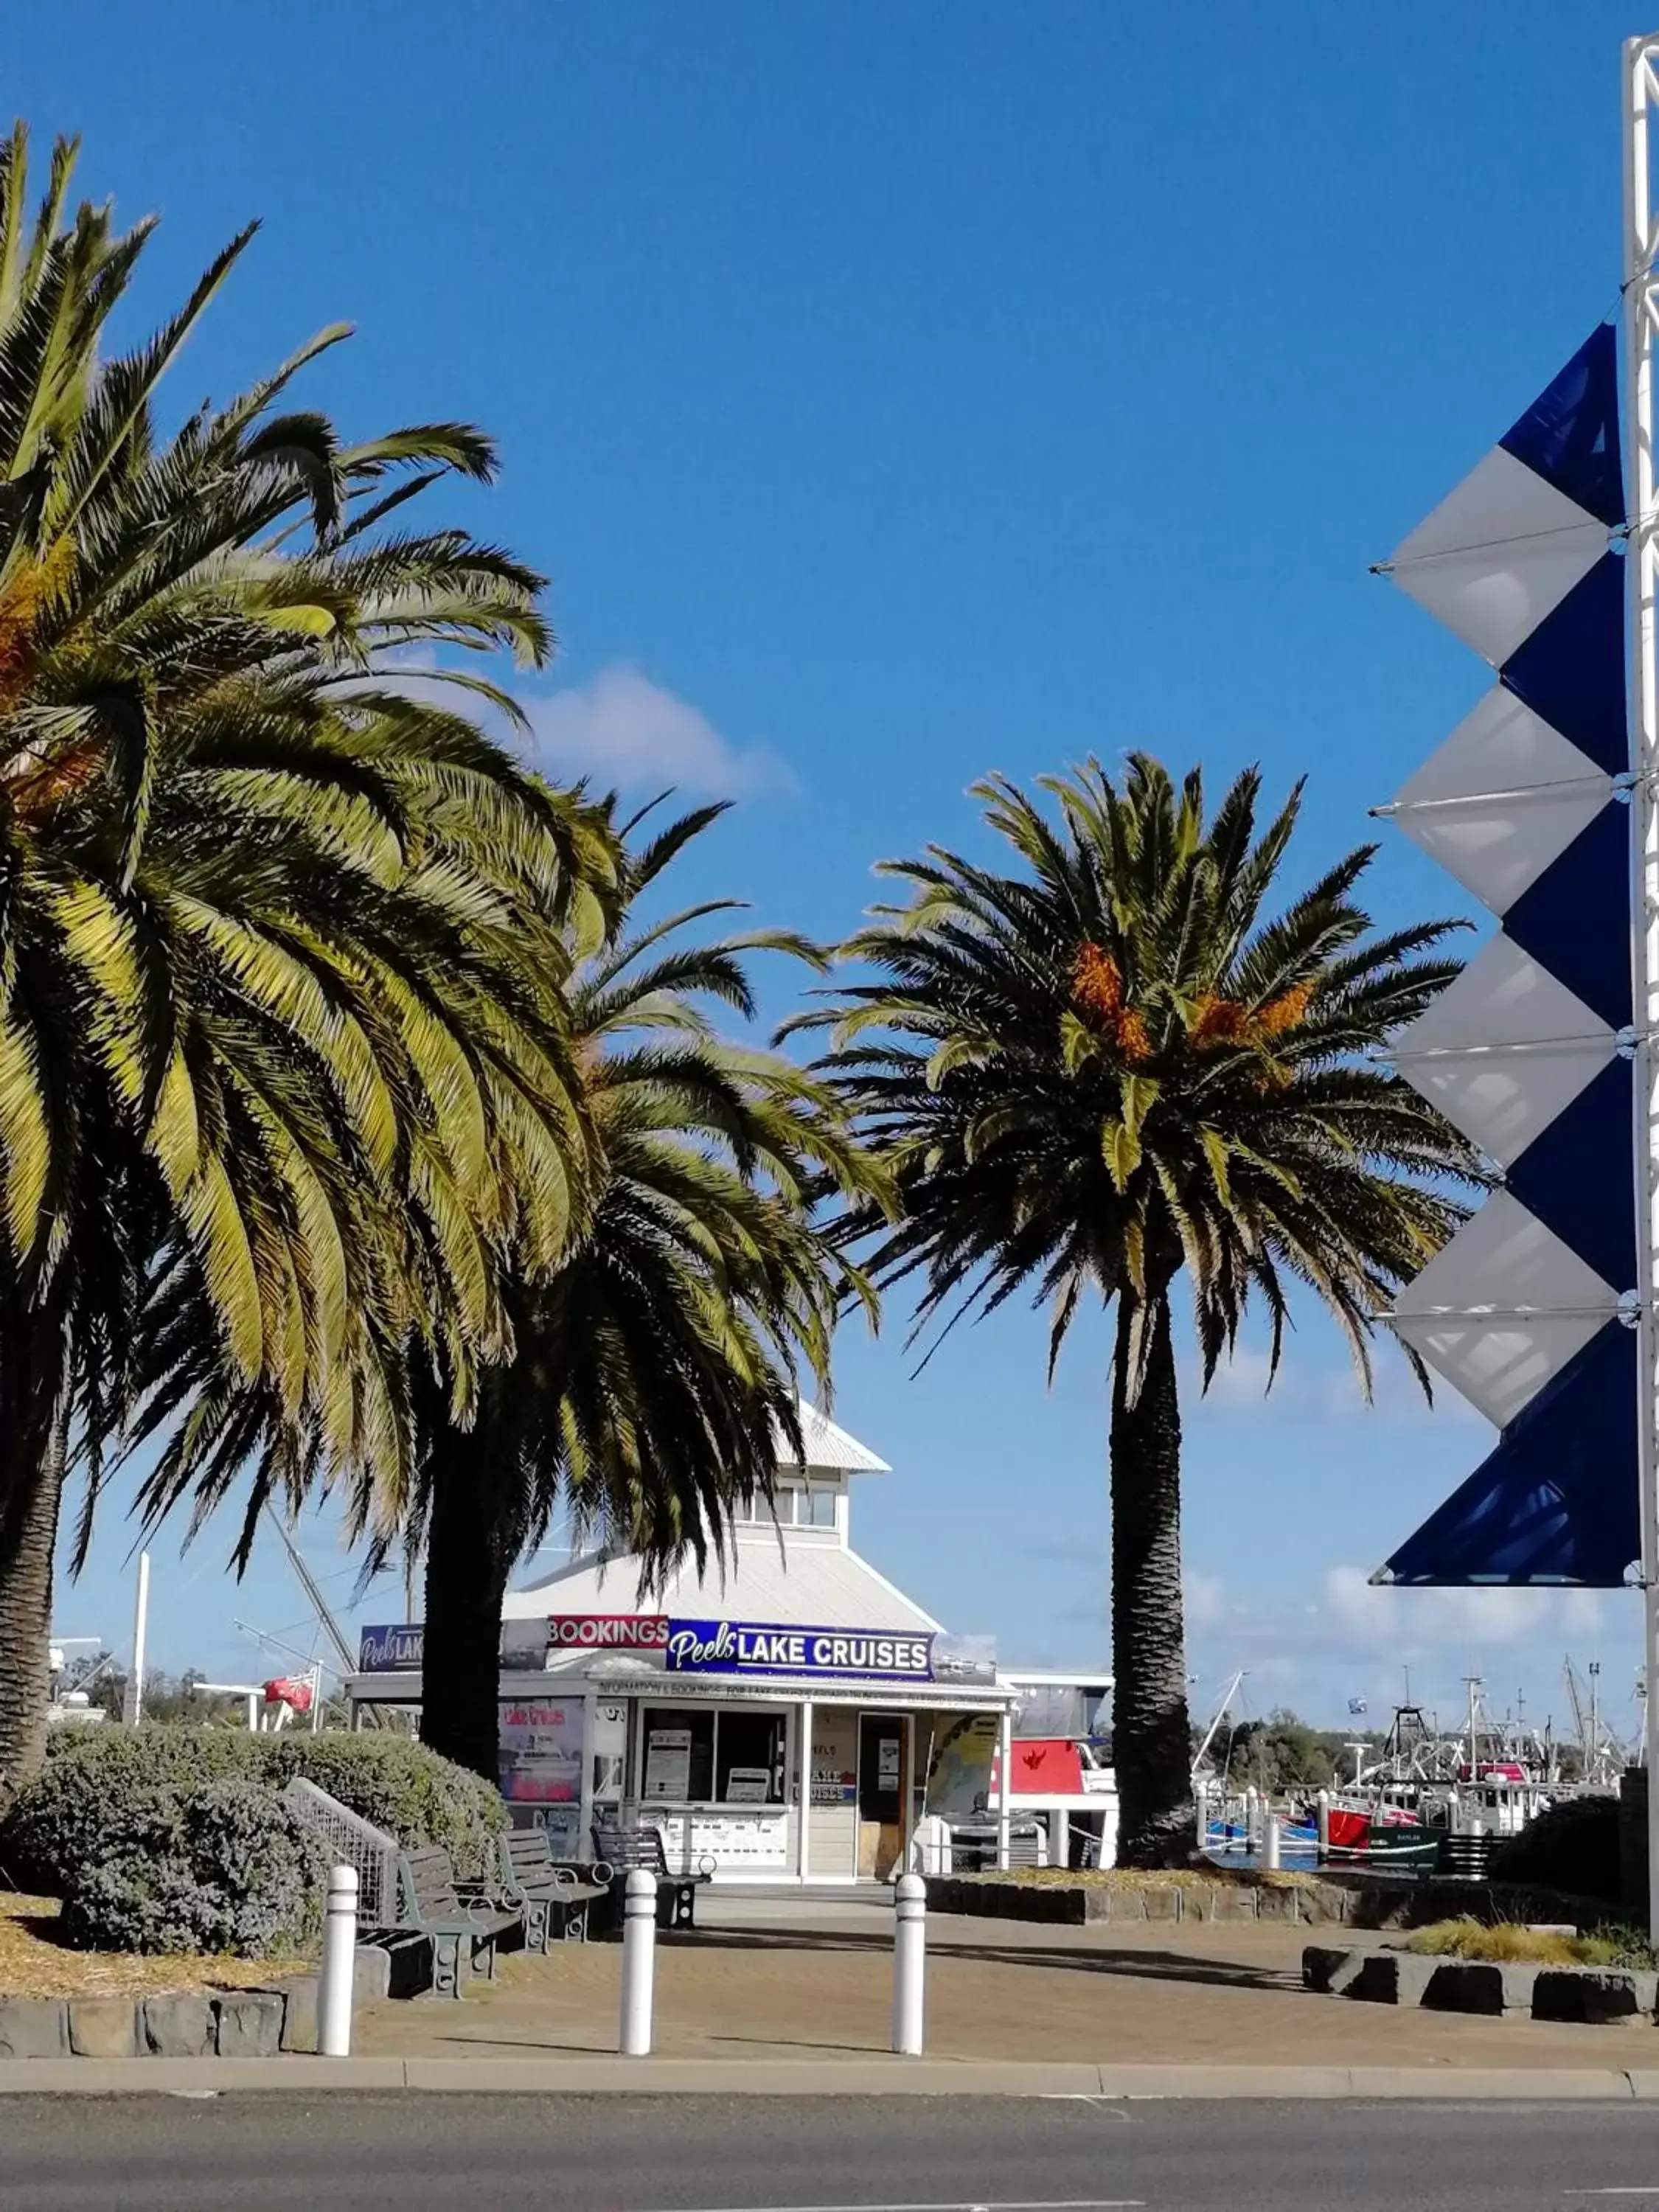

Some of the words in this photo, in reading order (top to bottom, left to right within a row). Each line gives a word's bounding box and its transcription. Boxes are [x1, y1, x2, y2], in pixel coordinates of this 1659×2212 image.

[361, 1627, 396, 1670] Peels
[396, 1636, 423, 1660] LAK
[548, 1620, 669, 1644] BOOKINGS
[669, 1622, 737, 1669] Peels
[739, 1634, 806, 1663] LAKE
[813, 1638, 928, 1669] CRUISES
